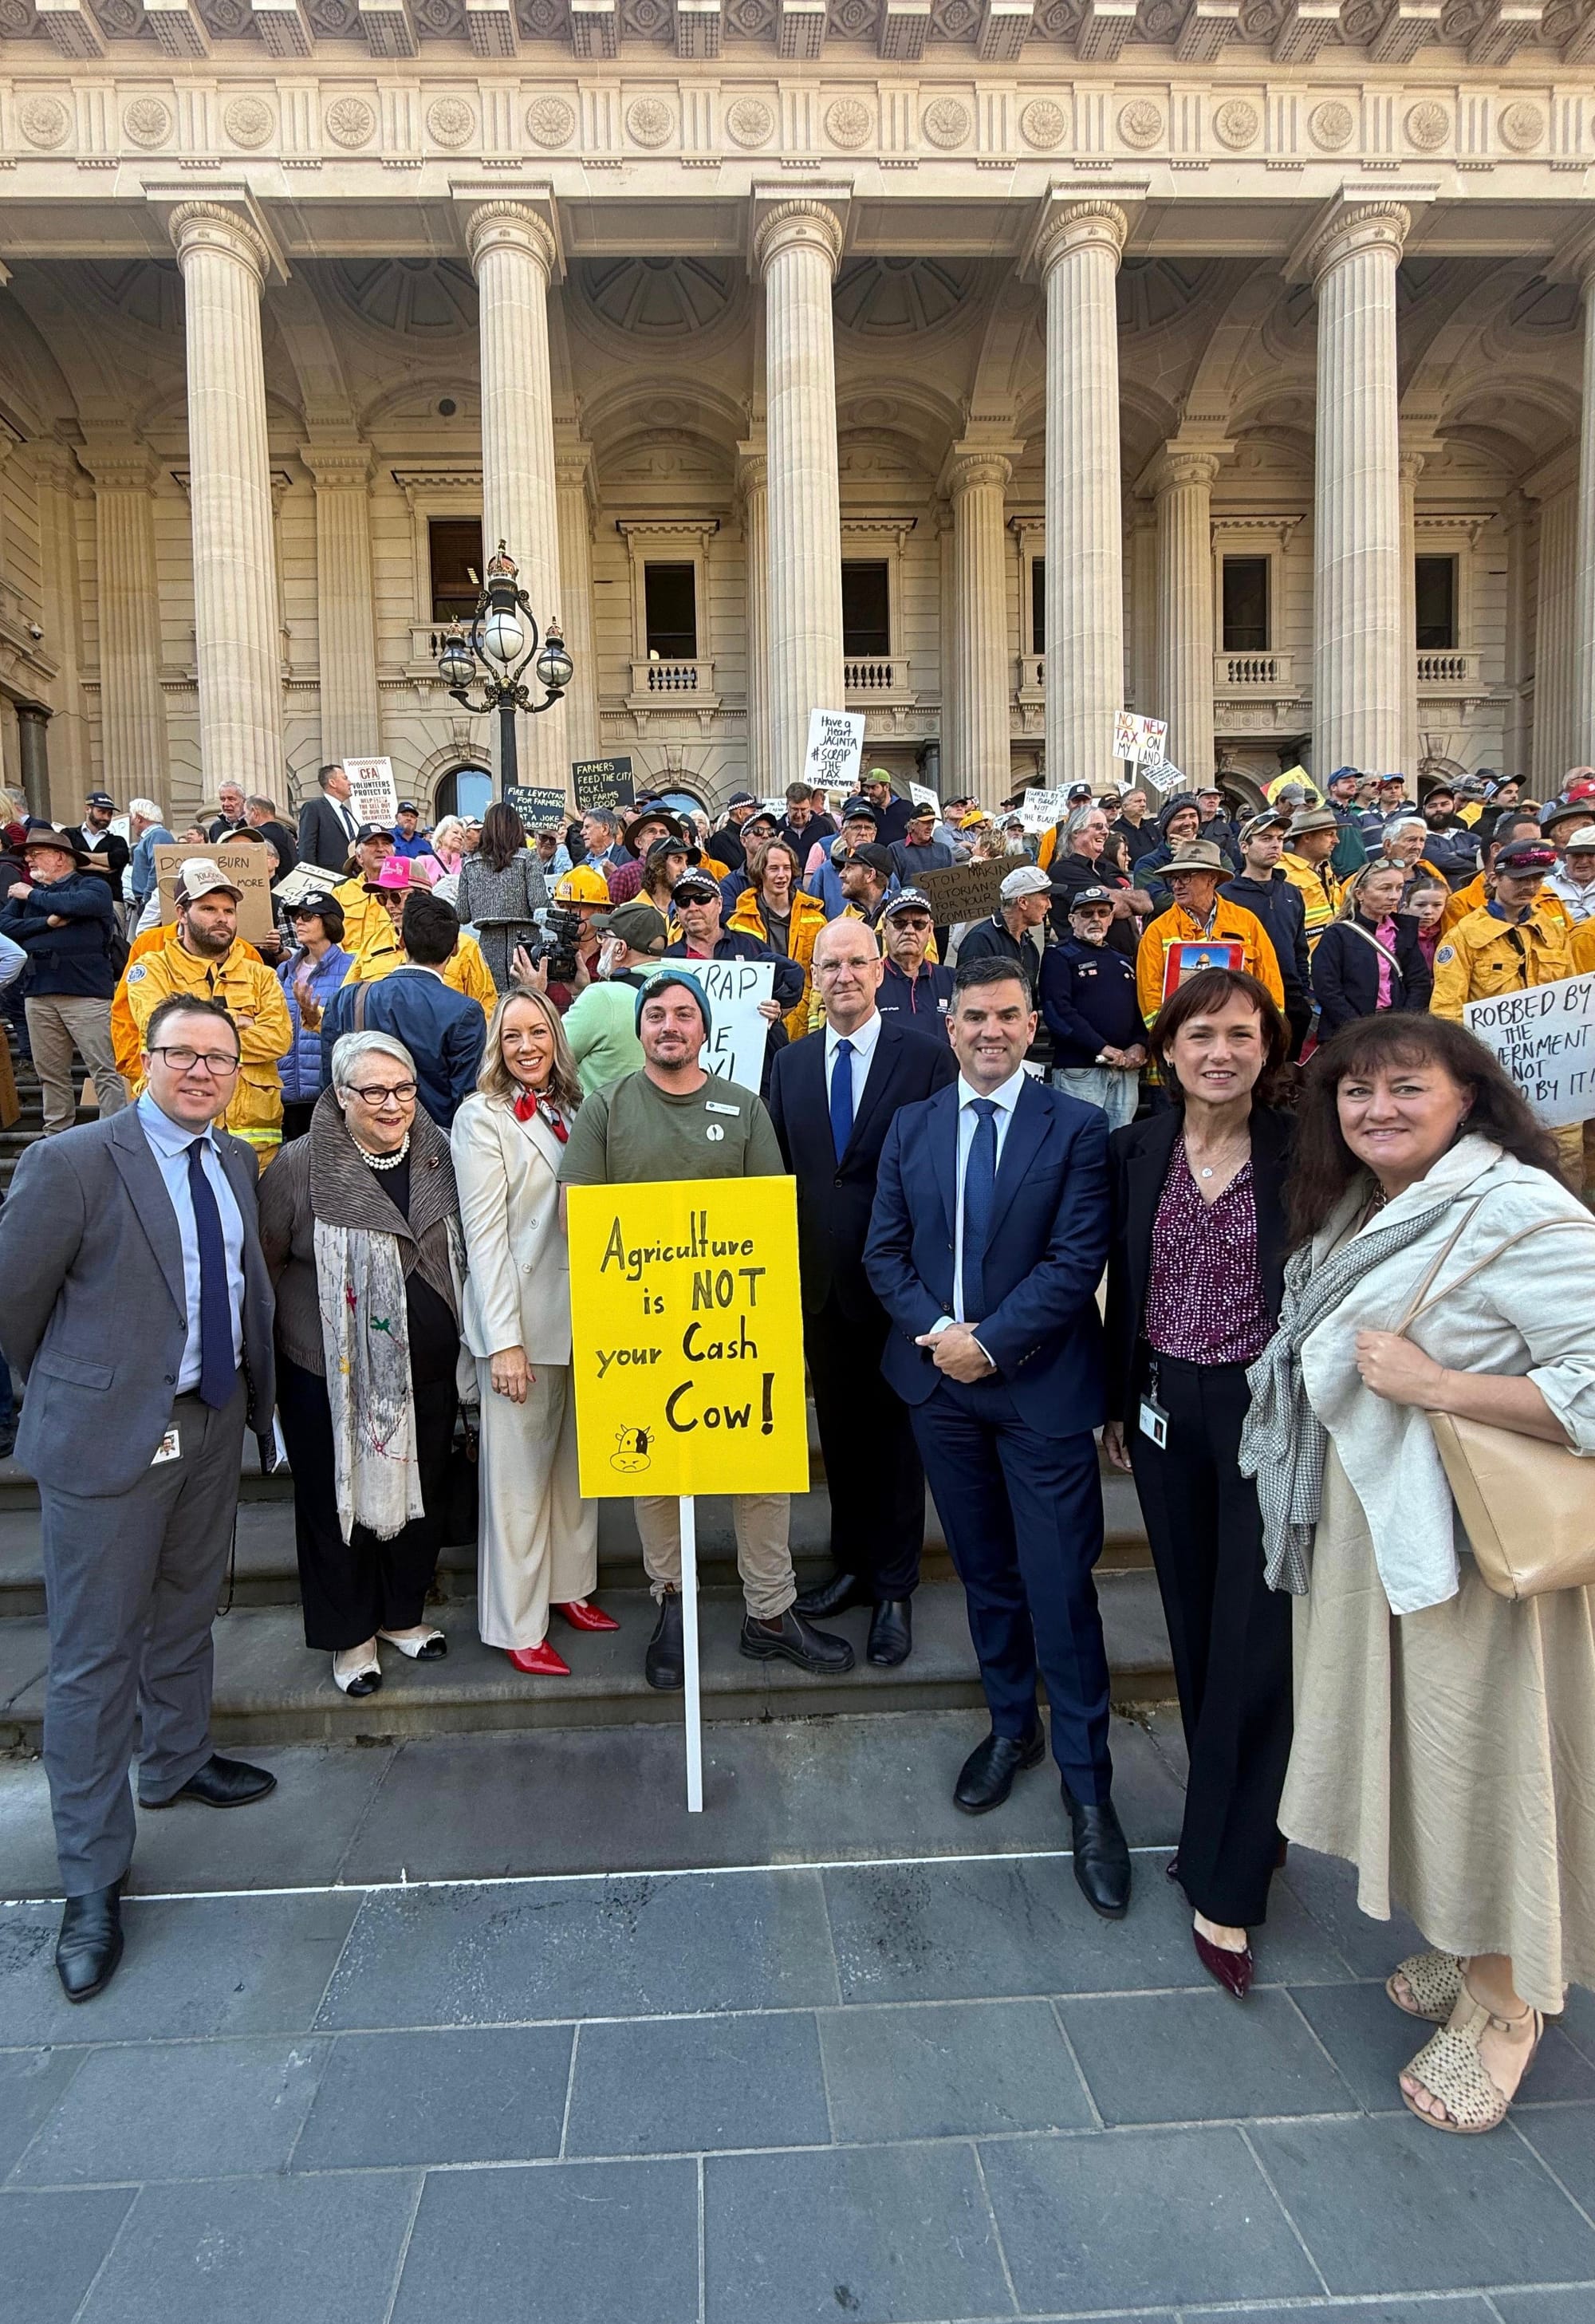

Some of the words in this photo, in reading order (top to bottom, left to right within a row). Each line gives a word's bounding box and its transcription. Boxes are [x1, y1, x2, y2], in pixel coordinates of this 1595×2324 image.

[821, 715, 842, 727] Have
[1119, 712, 1133, 727] NO
[1143, 719, 1166, 735] NEW
[827, 727, 853, 737] Heart
[1116, 727, 1138, 744] TAX
[1147, 735, 1160, 750] ON
[819, 735, 857, 750] JACINTA
[1117, 742, 1131, 758] MY
[1138, 746, 1160, 766] LAND
[577, 762, 615, 774] FARMERS
[821, 760, 841, 771] THE
[360, 767, 378, 780] CFA
[578, 774, 600, 784] FEED
[601, 773, 615, 782] THE
[616, 771, 632, 781] CITY
[817, 769, 840, 779] TAX
[352, 781, 391, 790] VOLUNTEERS
[508, 787, 525, 797] FIRE
[579, 782, 604, 794] FOLK!
[534, 798, 564, 808] FARMERS
[593, 791, 619, 802] FARMS
[594, 799, 616, 808] FOOD
[1024, 813, 1034, 822] THE
[218, 857, 250, 869] BURN
[237, 879, 265, 888] MORE
[920, 872, 960, 889] STOP
[936, 900, 957, 912] FOR
[960, 893, 994, 908] YOUR
[1471, 991, 1555, 1030] ROBBED
[1563, 983, 1592, 1014] BY
[1501, 1022, 1534, 1045] THE
[1512, 1059, 1546, 1081] NOT
[1535, 1080, 1558, 1101] BY
[600, 1211, 754, 1282] Agriculture
[644, 1287, 665, 1315] is
[691, 1267, 766, 1311] NOT
[595, 1347, 663, 1379] your
[682, 1314, 758, 1362] Cash
[665, 1373, 775, 1436] Cow!
